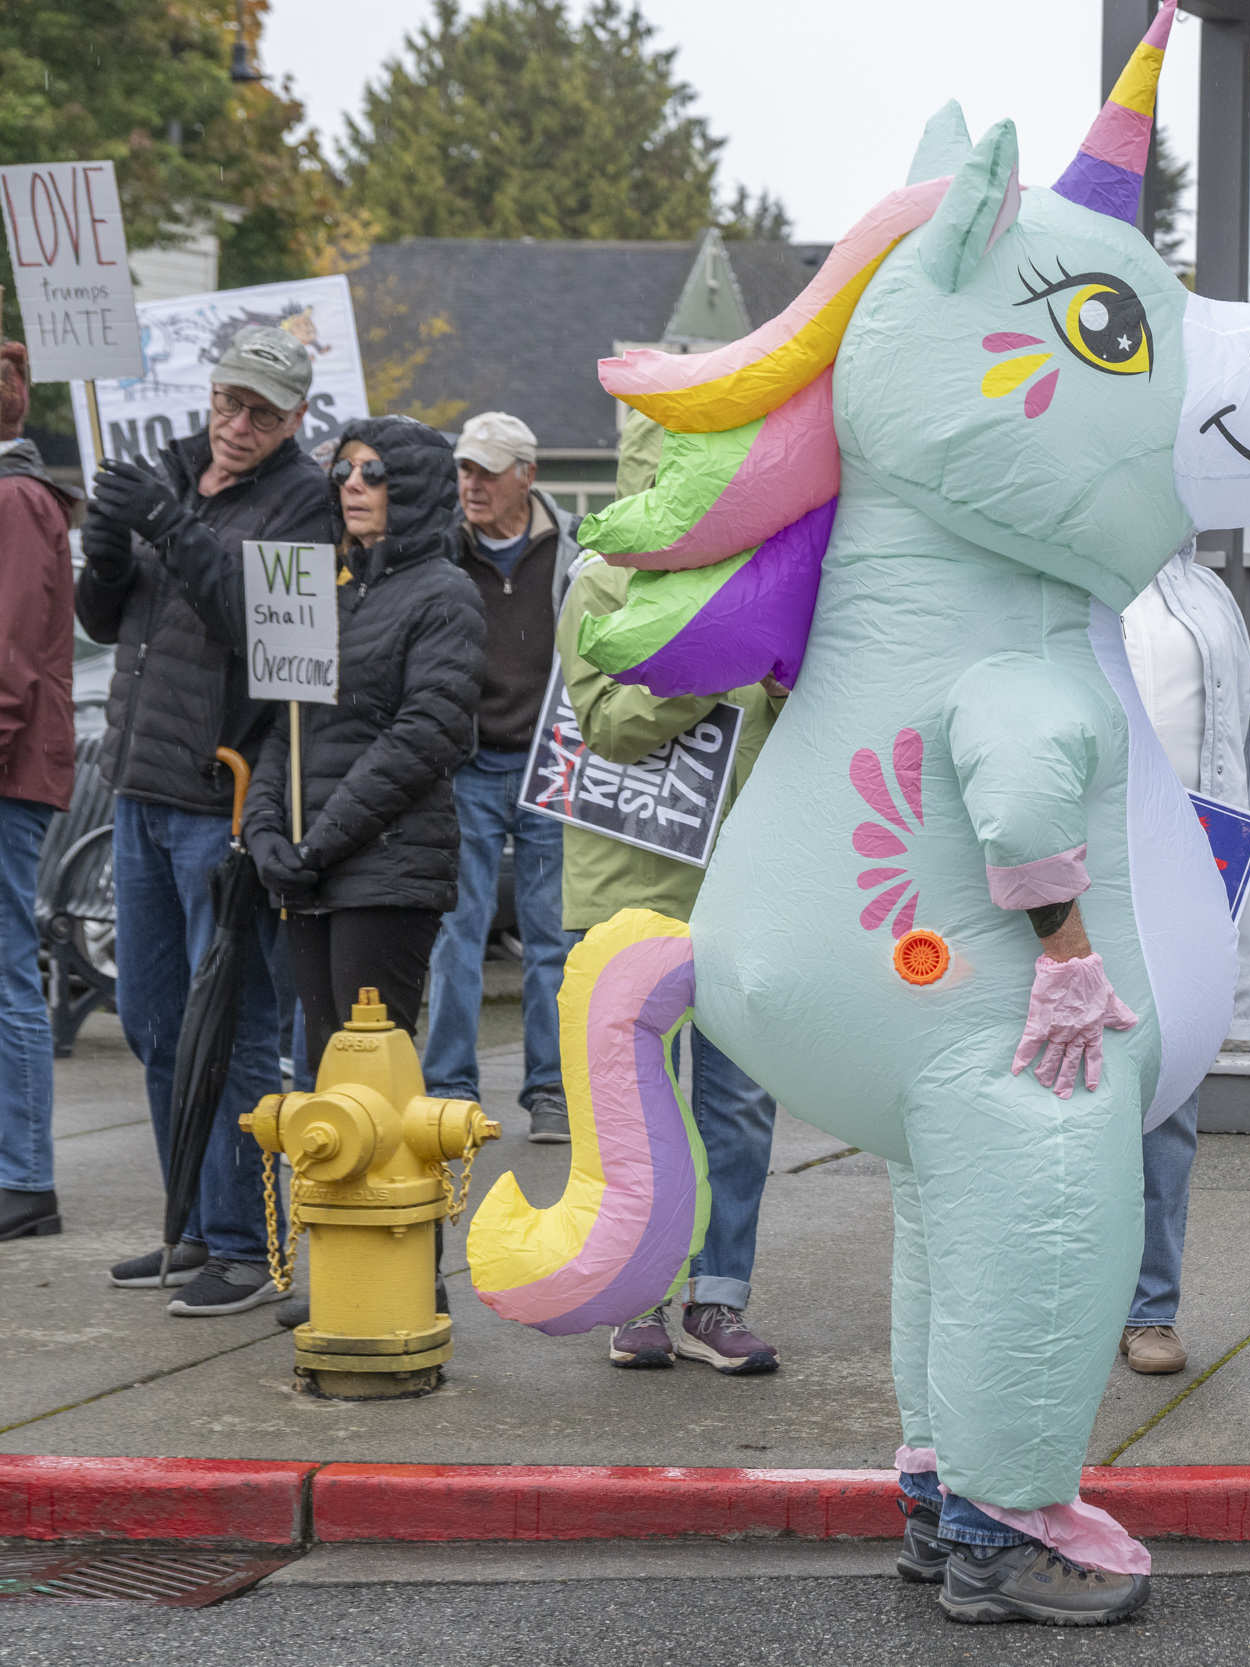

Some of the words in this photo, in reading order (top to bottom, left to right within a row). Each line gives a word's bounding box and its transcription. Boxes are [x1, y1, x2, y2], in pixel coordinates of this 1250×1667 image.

[2, 166, 118, 267] LOVE
[40, 276, 109, 304] trumps
[38, 308, 119, 347] HATE
[109, 415, 174, 465] NO
[258, 544, 317, 597] WE
[254, 603, 315, 629] Shall
[252, 638, 334, 687] Overcome
[656, 722, 723, 829] 1776
